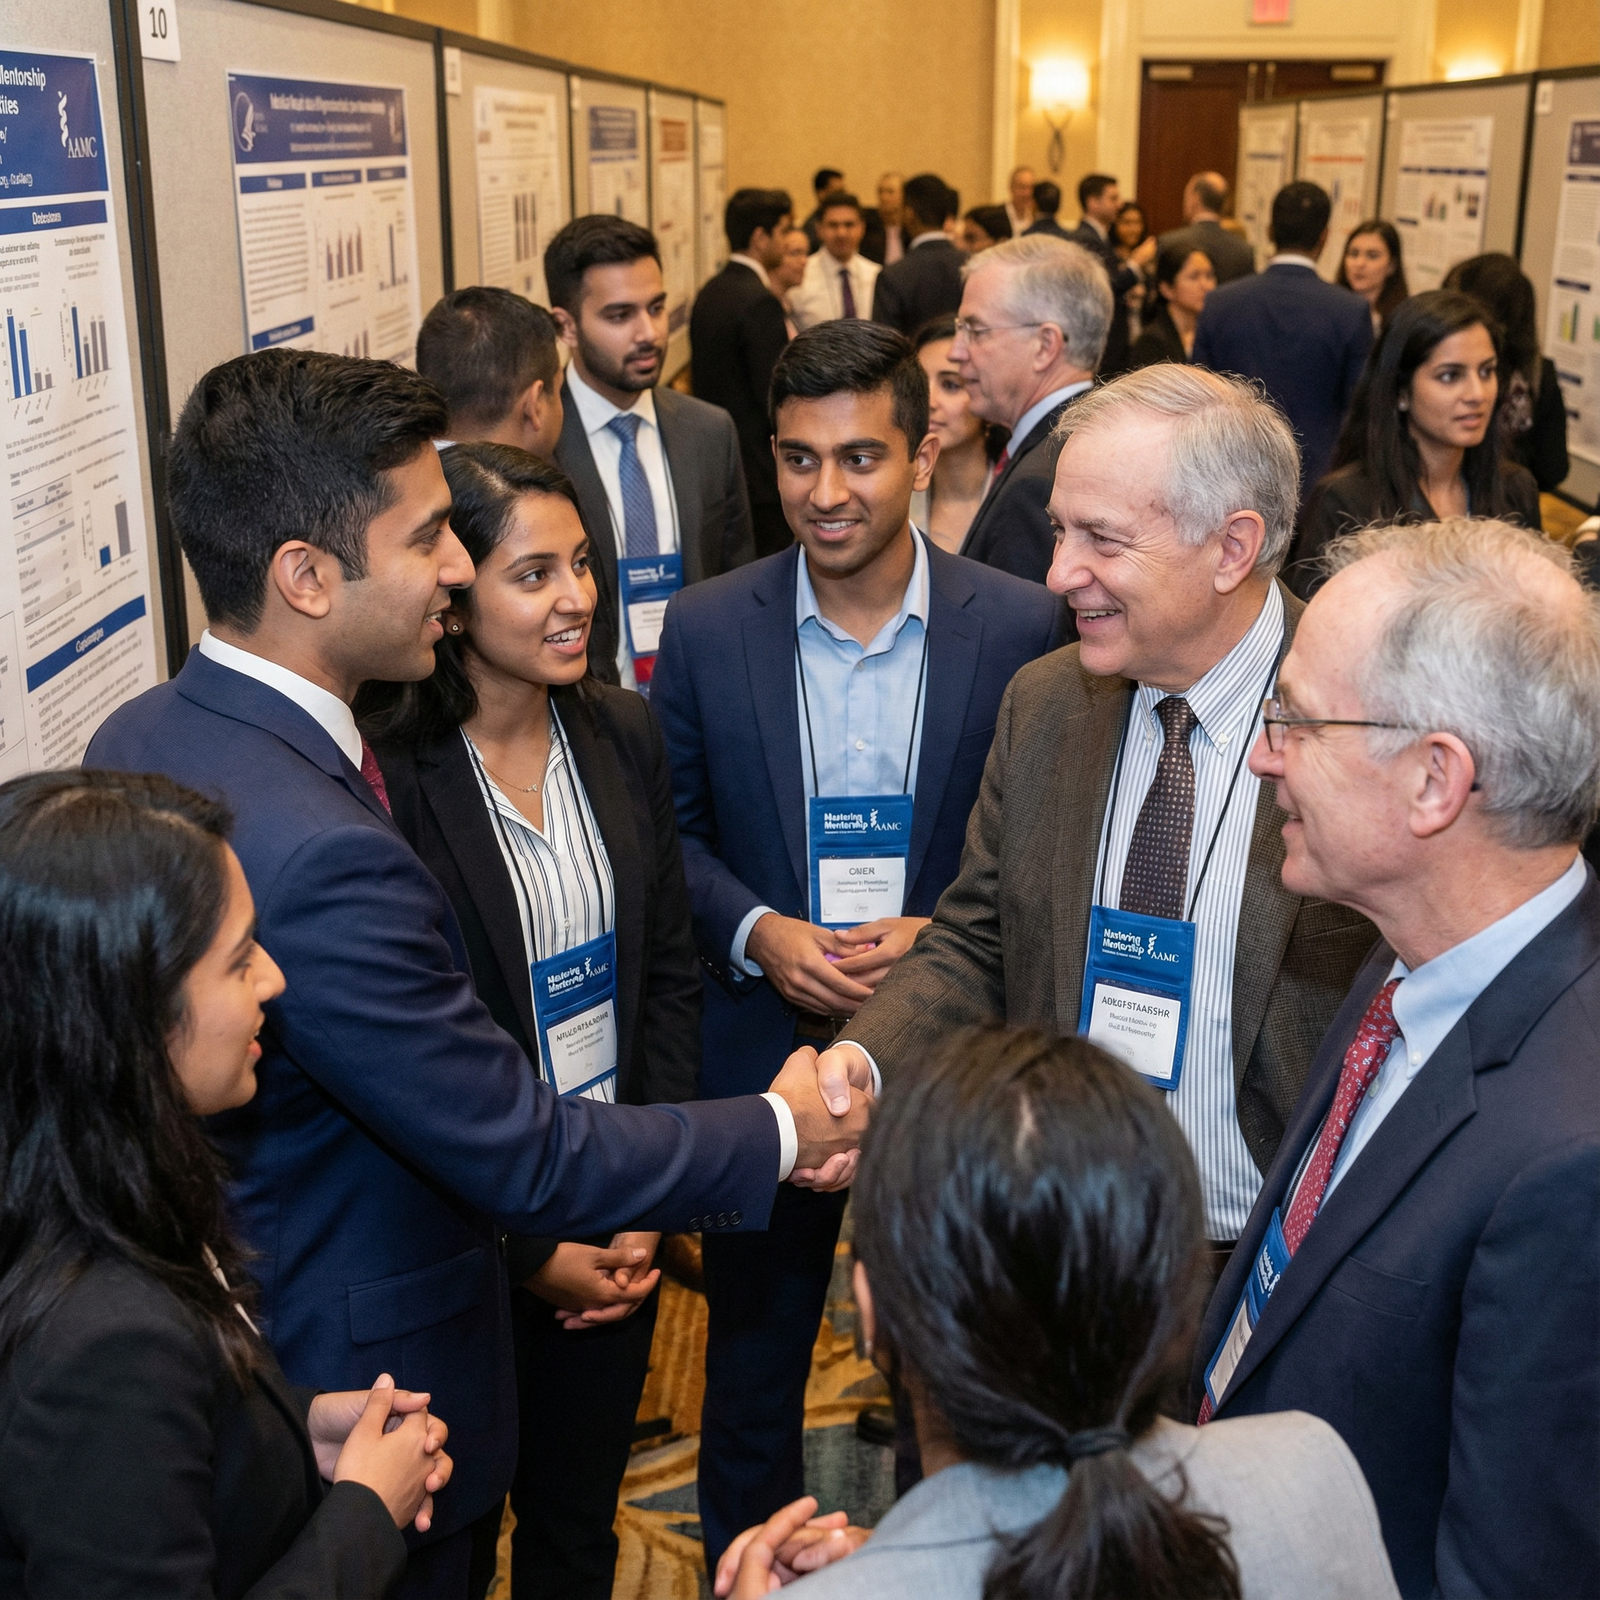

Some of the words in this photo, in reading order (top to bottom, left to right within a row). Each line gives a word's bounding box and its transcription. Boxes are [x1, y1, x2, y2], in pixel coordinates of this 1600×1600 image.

[149, 6, 168, 39] 10
[67, 136, 98, 158] AAMC
[874, 821, 902, 831] AAMC
[1150, 951, 1180, 963] AAMC
